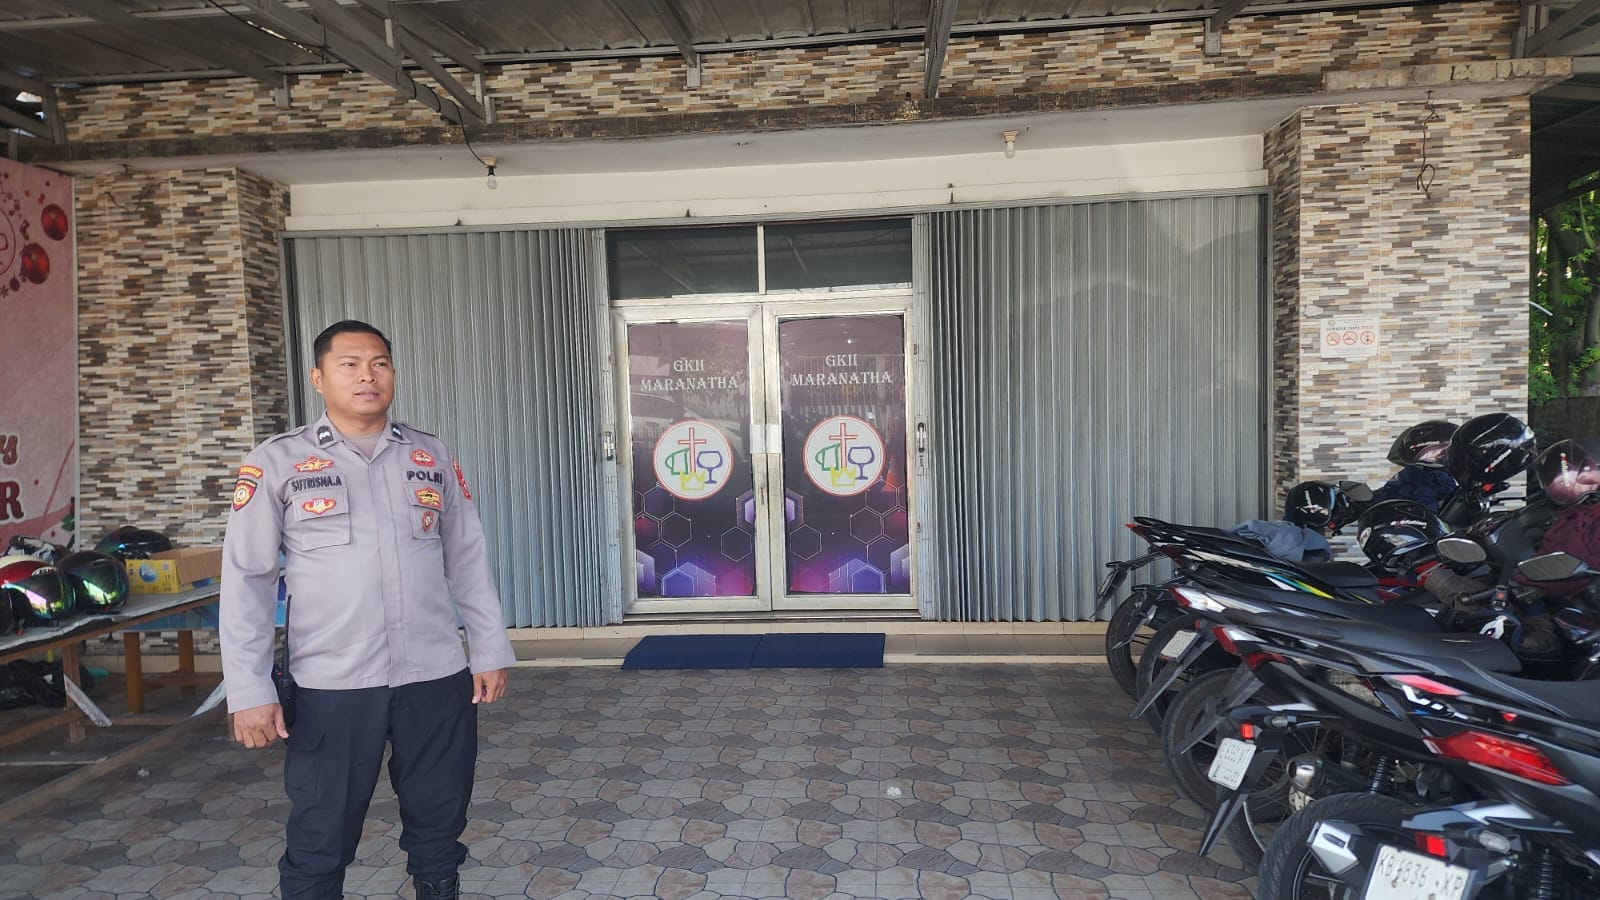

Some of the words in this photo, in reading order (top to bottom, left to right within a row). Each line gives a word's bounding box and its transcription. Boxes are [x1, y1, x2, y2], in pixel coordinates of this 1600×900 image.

[673, 360, 704, 372] GKII
[825, 354, 858, 367] GKII
[640, 376, 739, 391] MARANATHA
[792, 371, 893, 386] MARANATHA
[291, 475, 342, 492] SUTRISNA.A
[406, 470, 443, 485] POLRI
